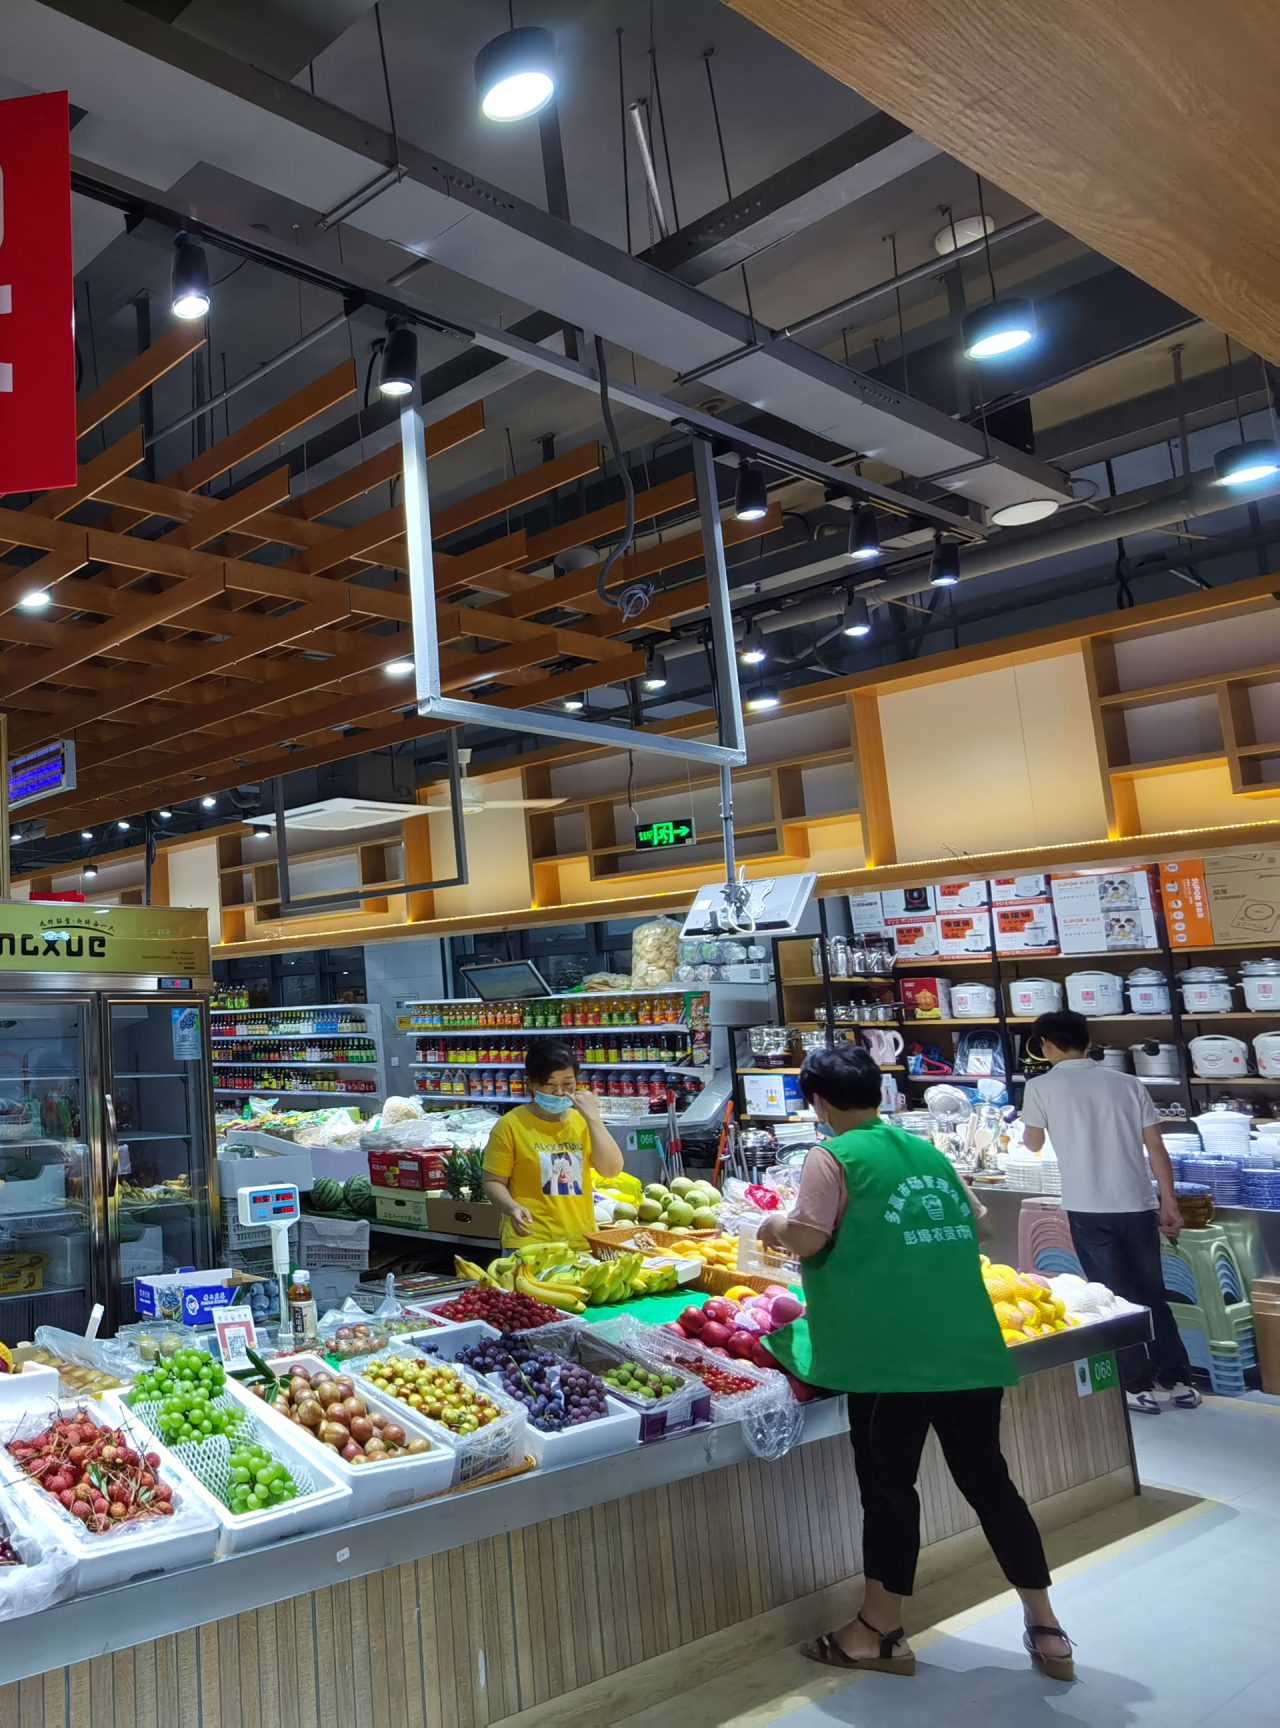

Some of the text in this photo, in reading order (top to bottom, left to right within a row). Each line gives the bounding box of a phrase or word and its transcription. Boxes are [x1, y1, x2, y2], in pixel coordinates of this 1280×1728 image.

[1191, 878, 1202, 901] SUPOR
[640, 1134, 654, 1145] 066
[1094, 1359, 1112, 1381] 068
